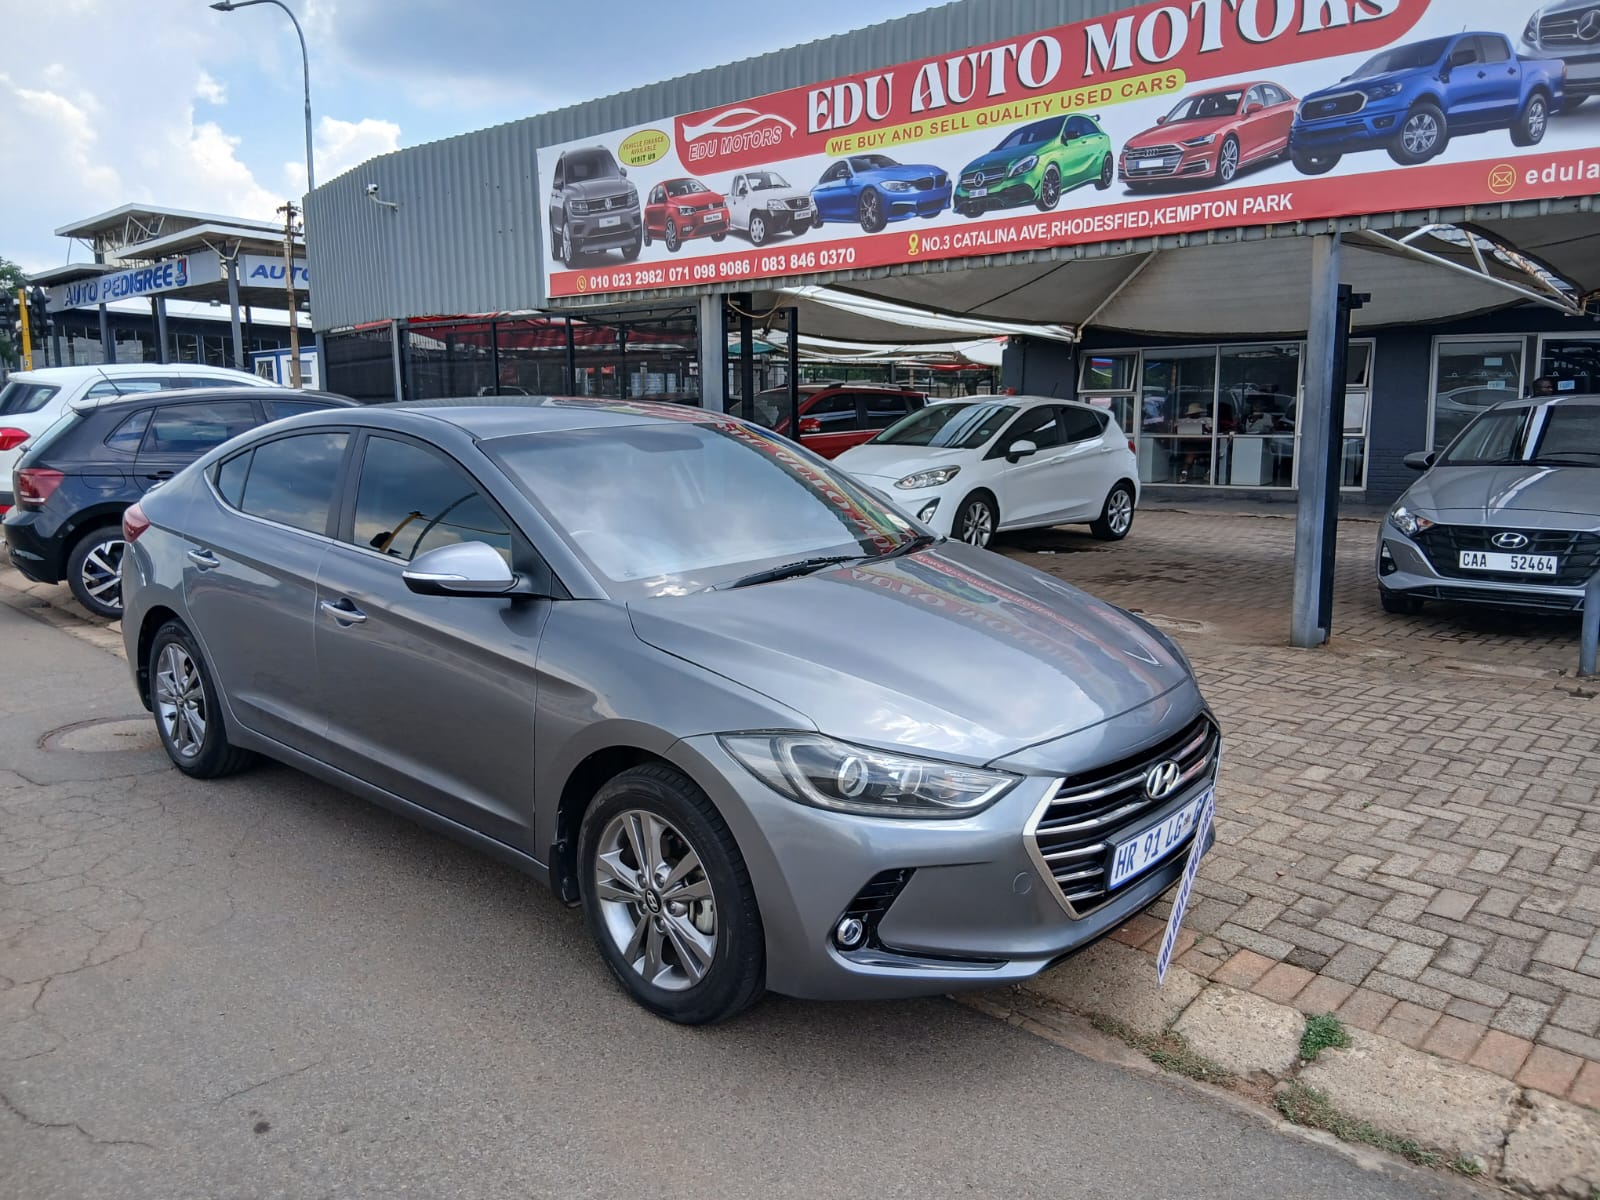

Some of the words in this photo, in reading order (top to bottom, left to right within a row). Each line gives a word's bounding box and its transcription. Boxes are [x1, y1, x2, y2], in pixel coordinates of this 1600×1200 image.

[807, 72, 894, 135] EDU
[910, 35, 1062, 113] AUTO
[831, 139, 852, 153] WE
[858, 133, 886, 148] BUY
[892, 126, 923, 142] AND
[930, 117, 970, 134] SELL
[976, 99, 1053, 126] QUALITY
[1060, 88, 1113, 110] USED
[1121, 75, 1178, 98] CARS
[631, 154, 646, 164] VISIT
[648, 153, 656, 161] US
[688, 139, 718, 162] EDU
[720, 126, 782, 155] MOTORS
[922, 236, 950, 252] NO.3
[953, 227, 1017, 248] CATALINA
[1242, 193, 1293, 215] PARK
[65, 282, 98, 306] AUTO
[103, 264, 173, 299] PEDIGREE
[590, 275, 609, 289] 010
[612, 273, 632, 287] 023
[669, 266, 689, 281] 071
[694, 263, 716, 279] 098
[720, 260, 750, 276] 9086
[761, 255, 786, 271] 083
[790, 252, 815, 269] 846
[820, 248, 855, 265] 0370
[1463, 553, 1487, 567] CAA
[1511, 556, 1553, 571] 52464
[1115, 841, 1138, 879] HR
[1144, 827, 1162, 862] 91
[1165, 812, 1184, 848] LG
